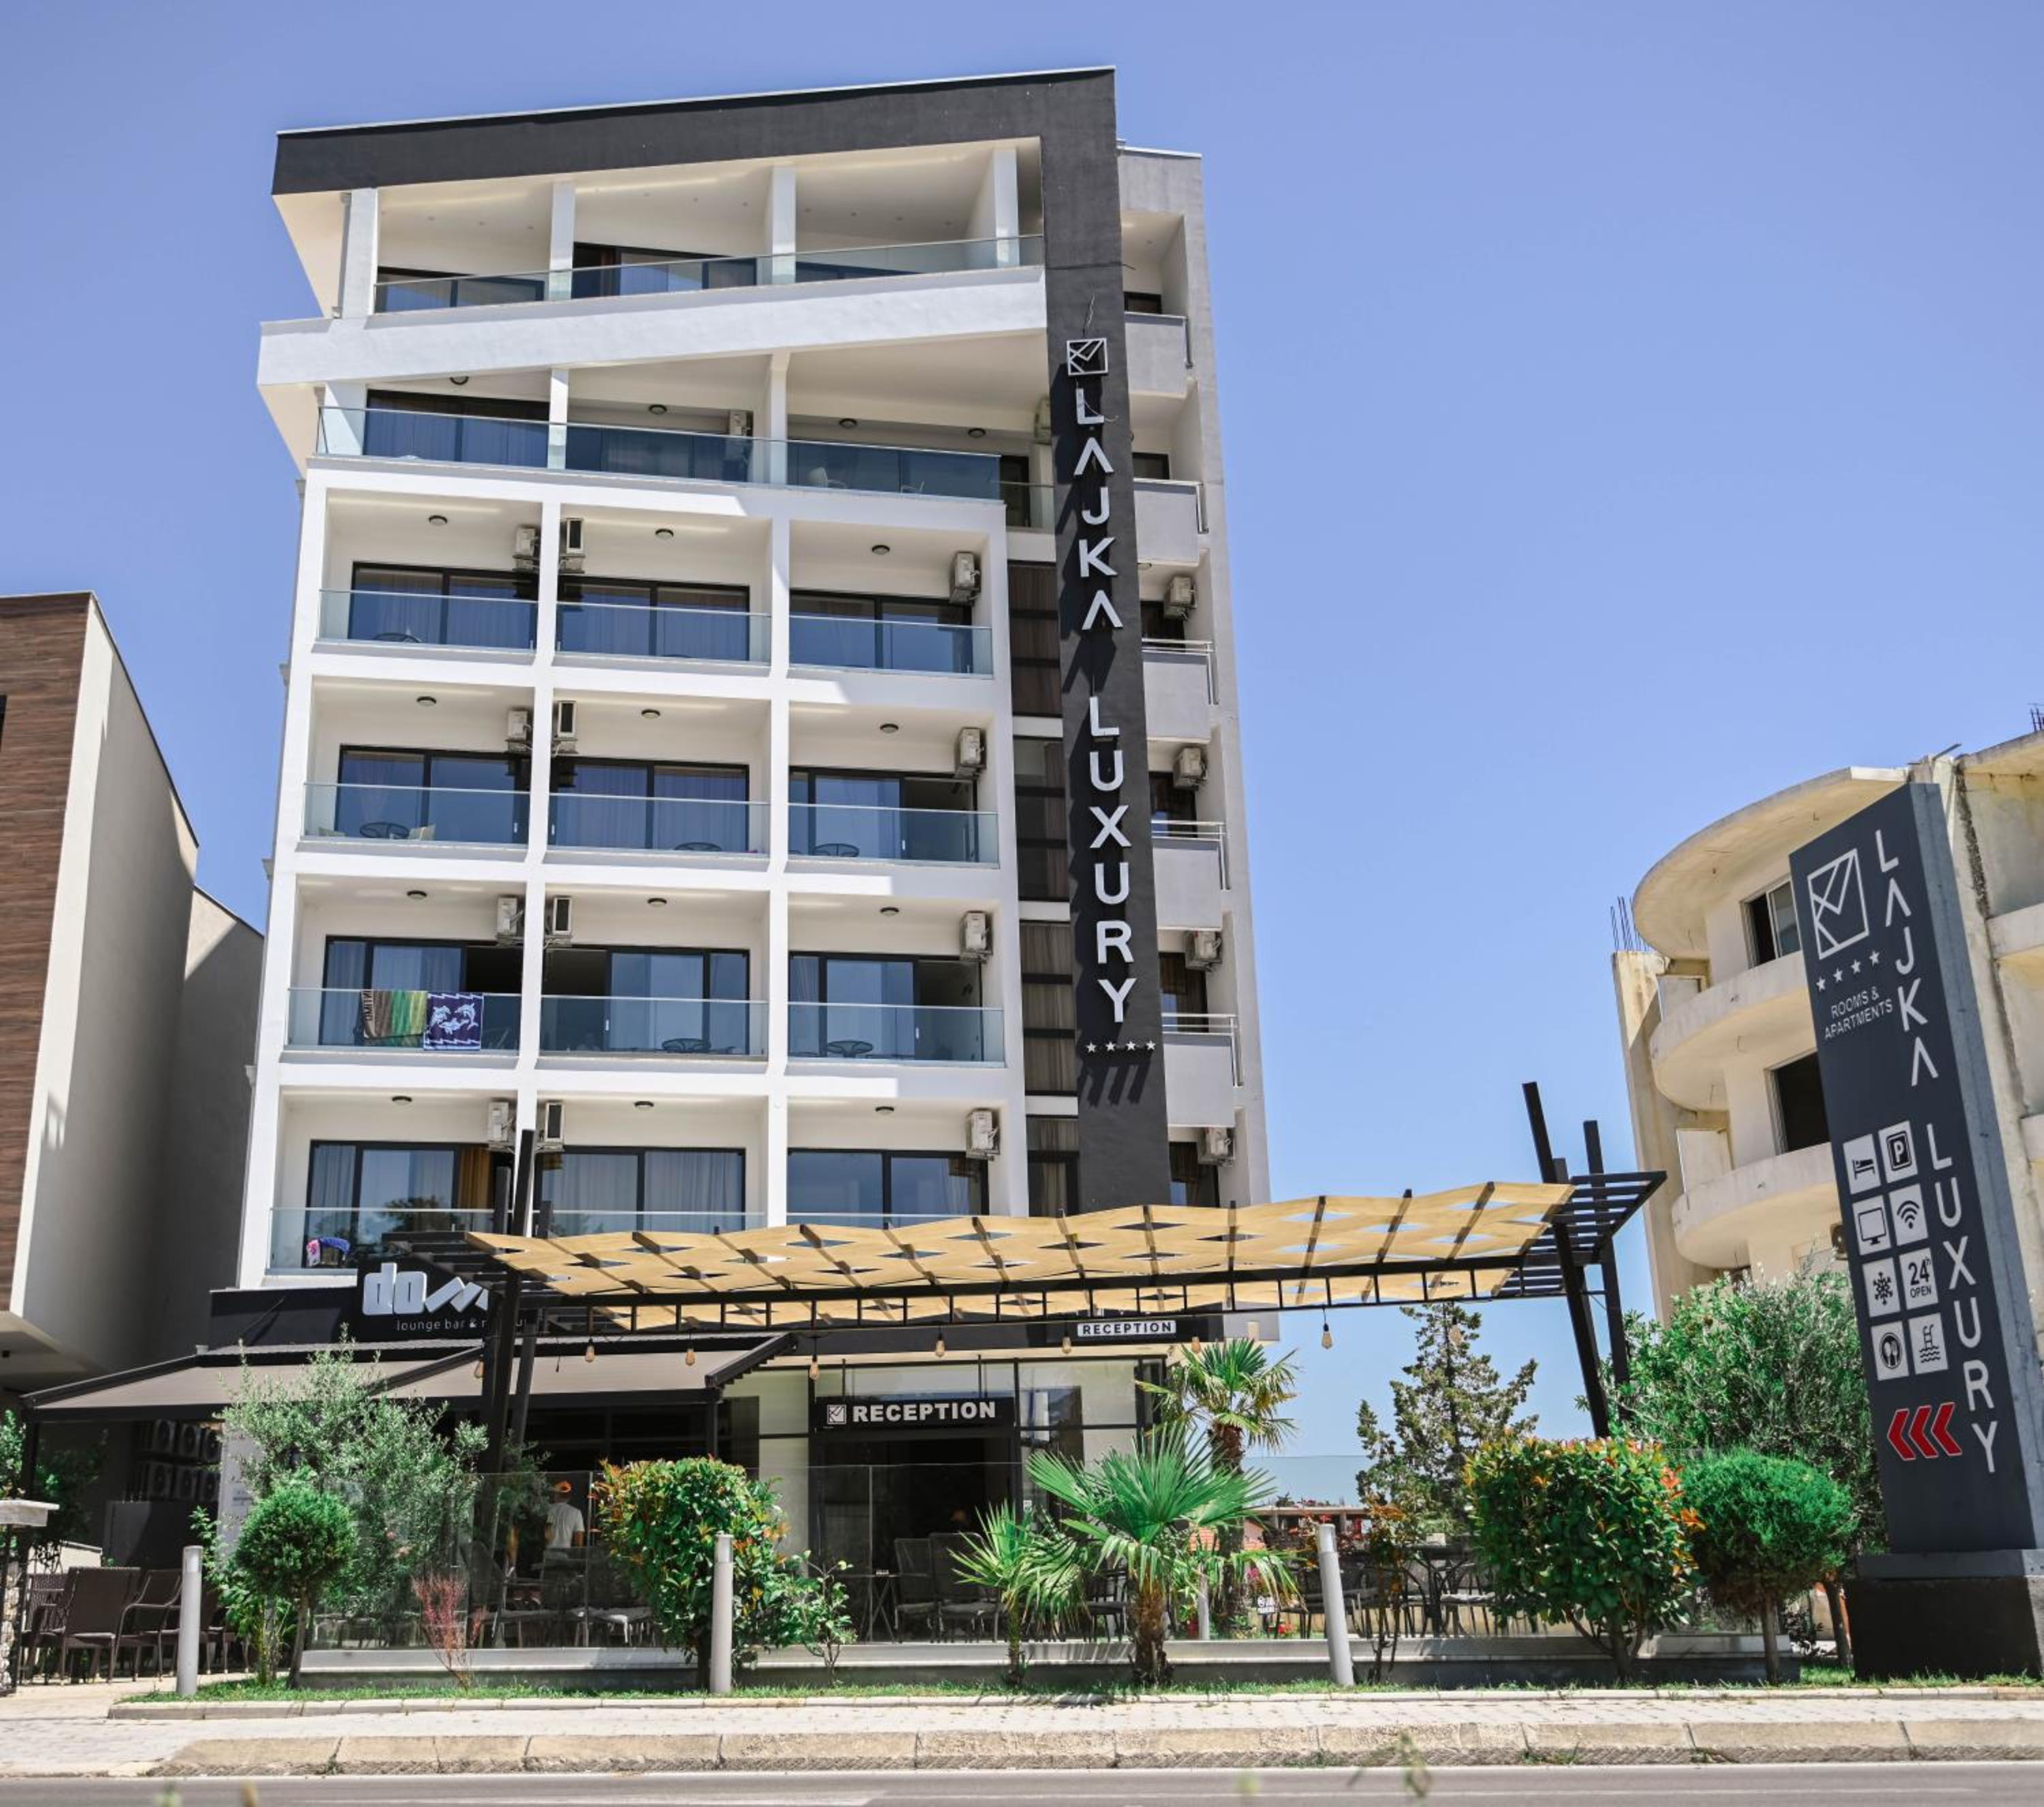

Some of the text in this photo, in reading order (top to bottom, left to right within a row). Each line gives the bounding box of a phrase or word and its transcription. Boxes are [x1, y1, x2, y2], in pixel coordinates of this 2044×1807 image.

[1074, 388, 1137, 1023] LAJKA LUXURY
[1831, 986, 1880, 1019] ROOMS &
[1825, 998, 1893, 1040] APARTMENTS
[1875, 829, 1998, 1473] LAJKA LUXURY
[1910, 1284, 1932, 1298] OPEN
[397, 1319, 441, 1332] lounge
[445, 1318, 466, 1329] bar
[1083, 1322, 1171, 1335] RECEPTION
[852, 1401, 996, 1423] RECEPTION
